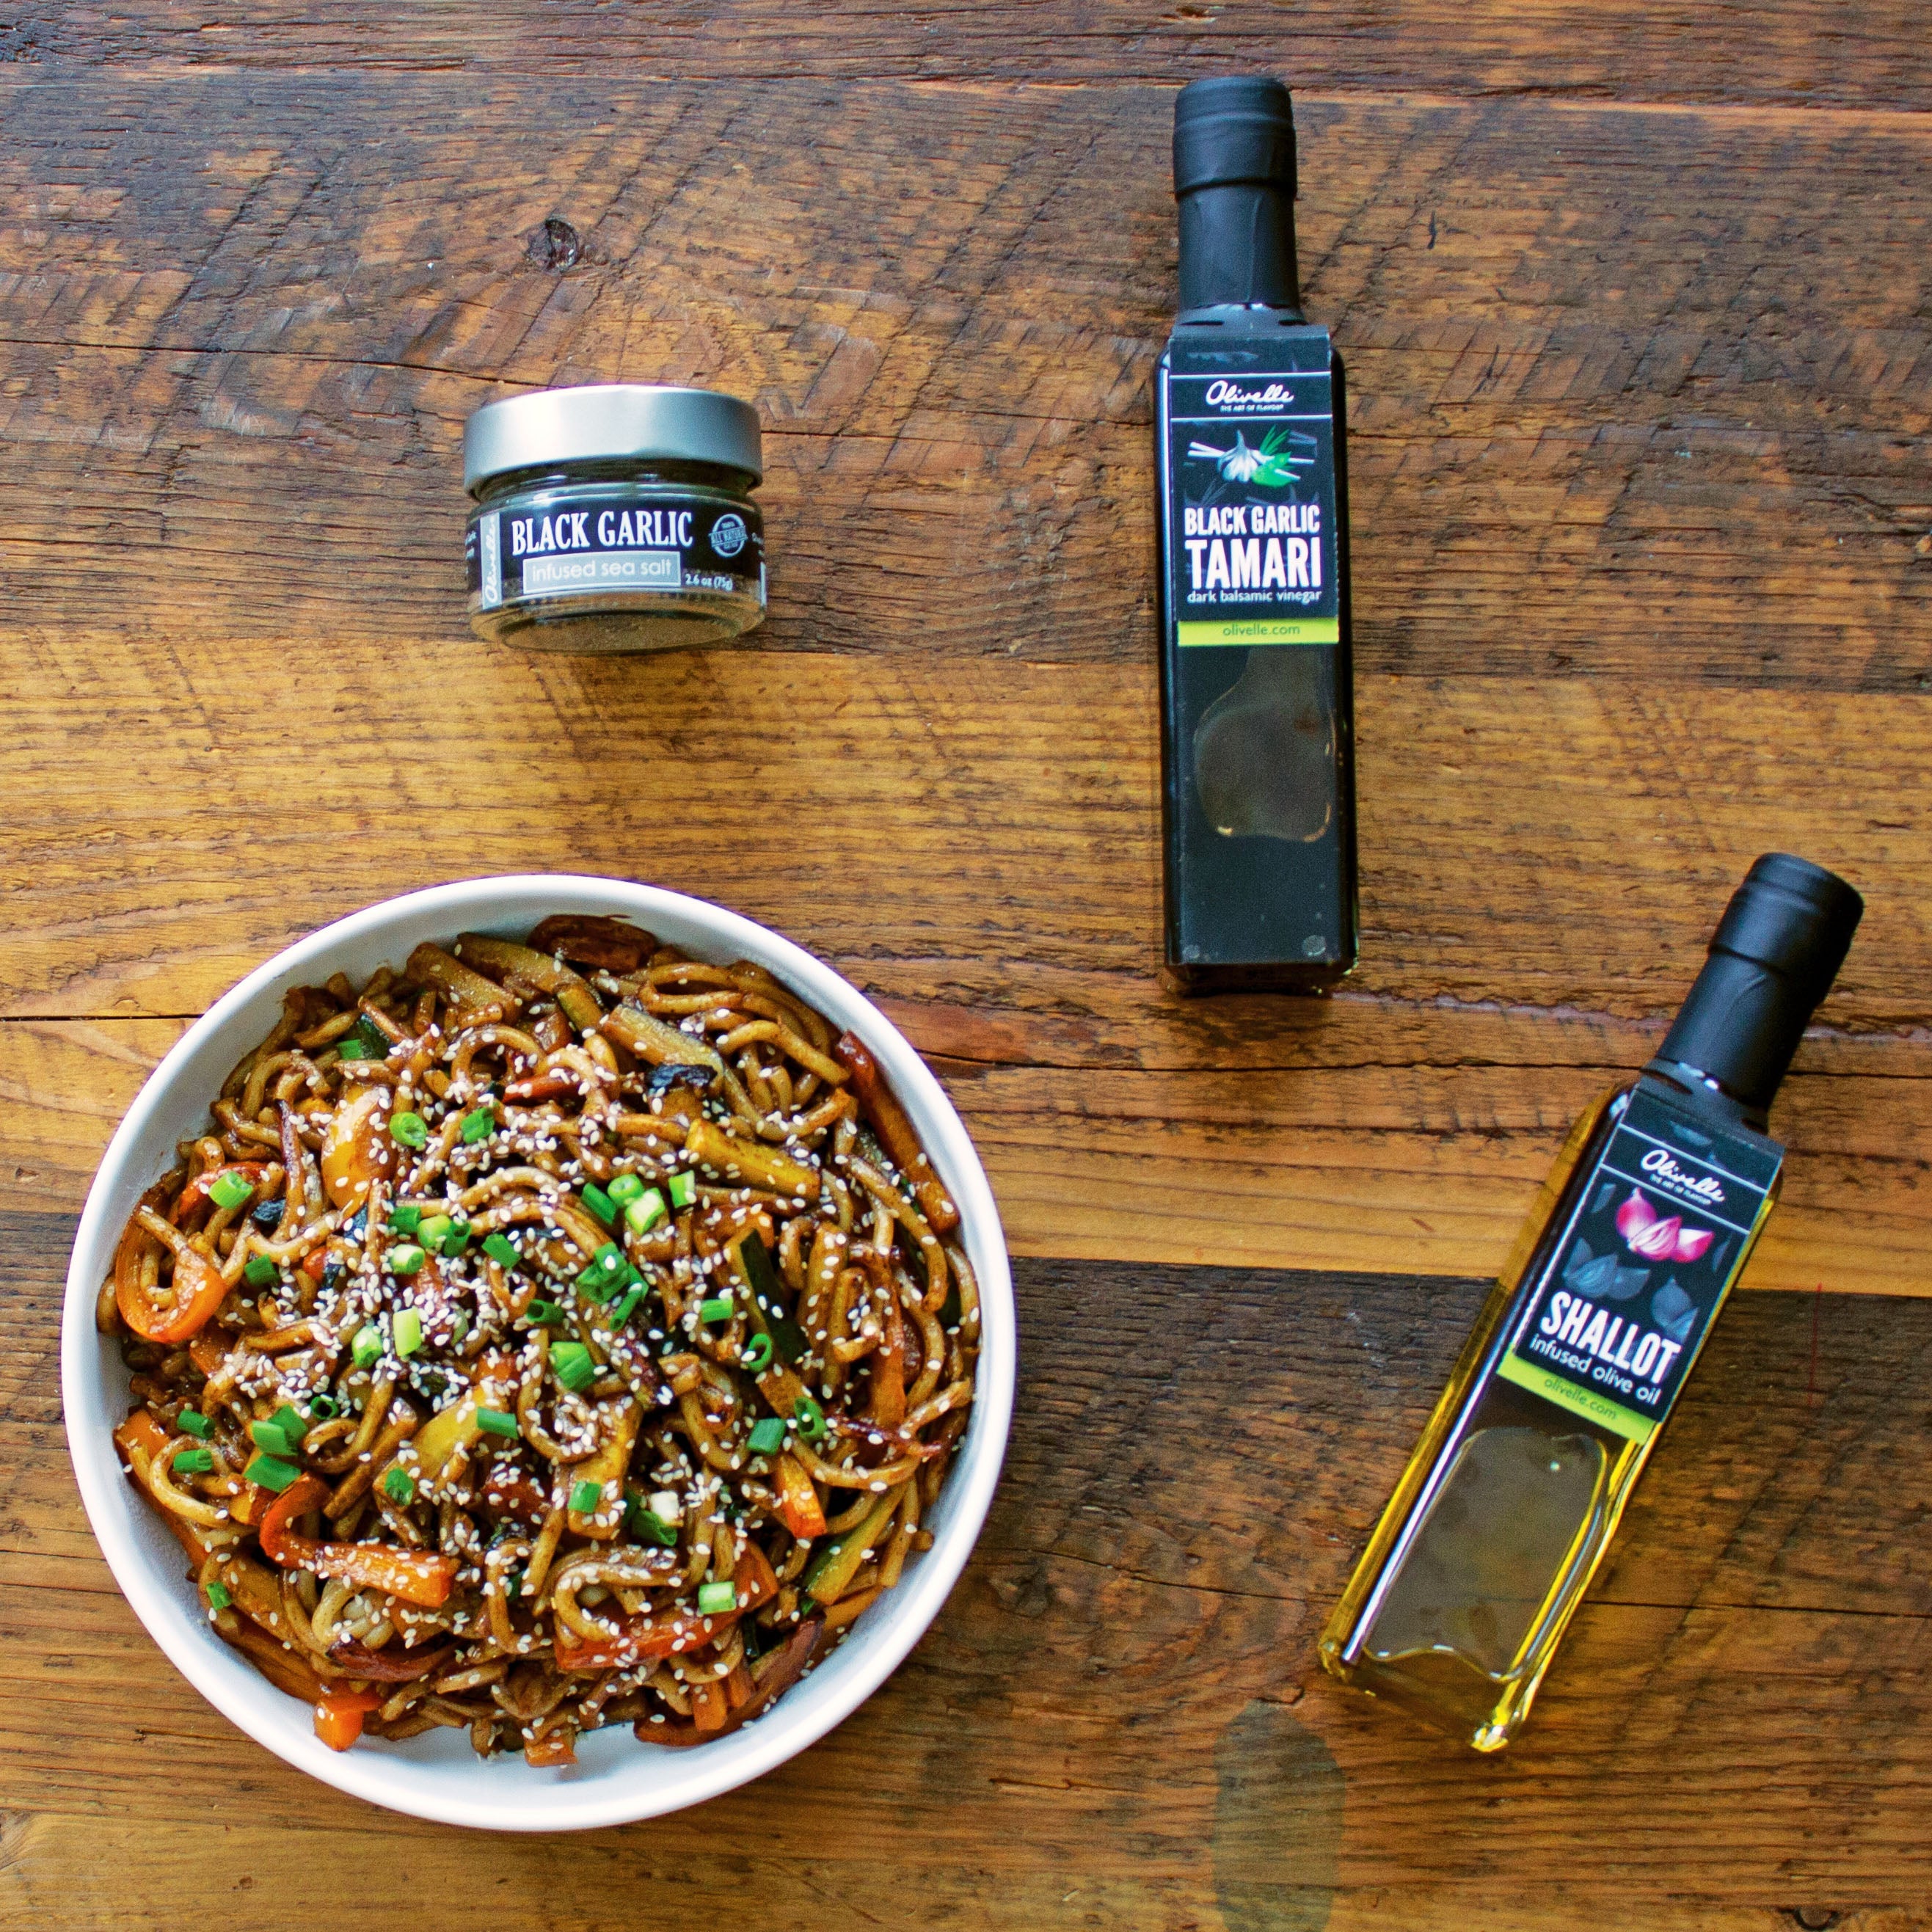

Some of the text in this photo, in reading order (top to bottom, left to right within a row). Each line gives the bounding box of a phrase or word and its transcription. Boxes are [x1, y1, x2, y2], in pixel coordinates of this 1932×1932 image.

[1206, 380, 1294, 405] Olivelle
[511, 510, 693, 556] BLACK GARLIC
[1184, 505, 1320, 536] BLACK GARLIC
[532, 558, 672, 583] infused sea salt
[1184, 537, 1322, 589] TAMARI
[1187, 590, 1322, 605] dark balsamic vinegar
[1222, 624, 1300, 637] olivelle.com
[1641, 1149, 1726, 1202] Olivelle
[1539, 1291, 1683, 1385] SHALLOT
[1529, 1333, 1663, 1405] infused olive oil
[1544, 1375, 1618, 1420] olivelle.com
